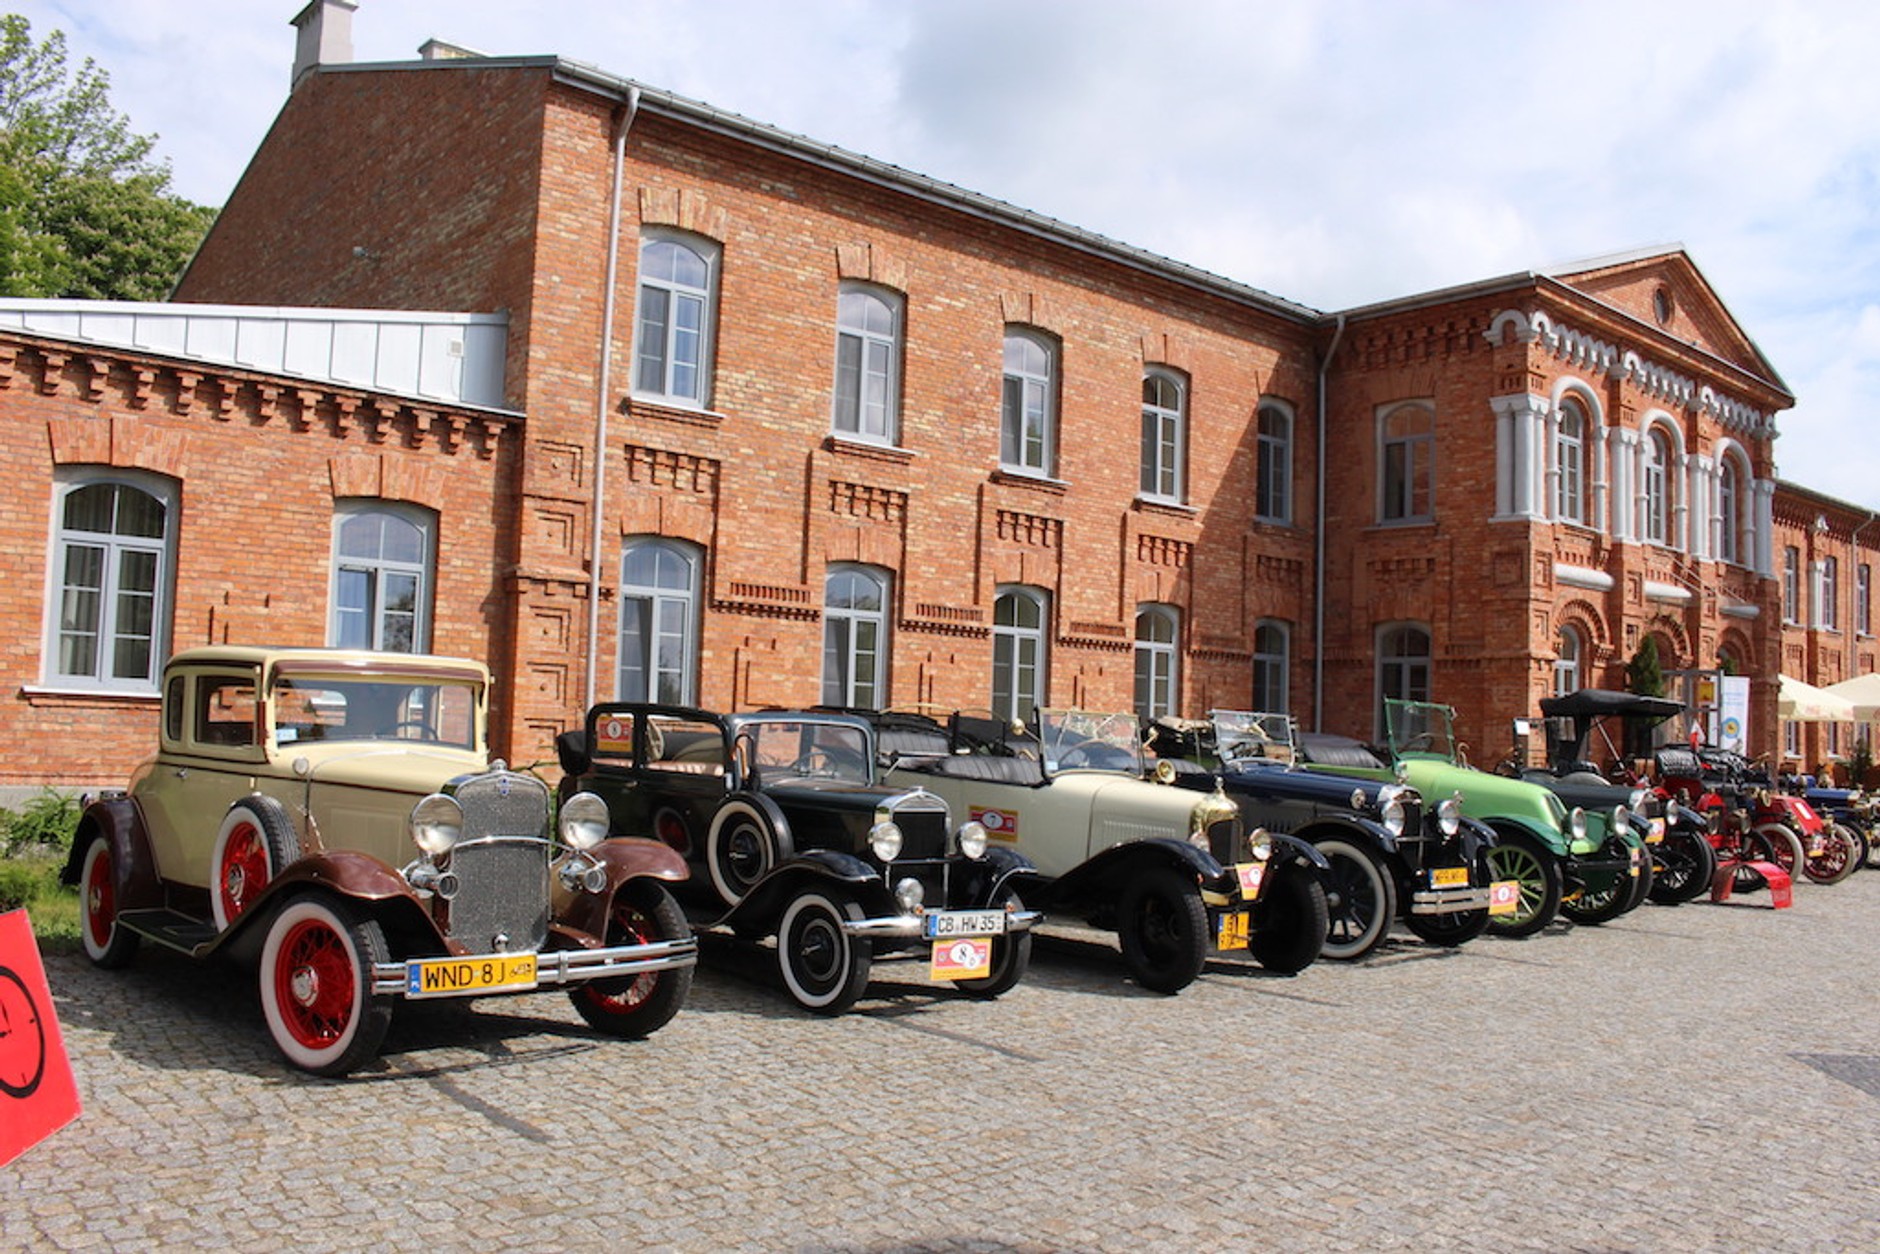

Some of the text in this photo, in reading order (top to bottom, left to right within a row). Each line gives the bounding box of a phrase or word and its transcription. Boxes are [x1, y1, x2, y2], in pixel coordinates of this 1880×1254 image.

[938, 917, 954, 933] CB
[961, 916, 978, 932] HW
[980, 915, 995, 931] 35
[425, 965, 473, 988] WND
